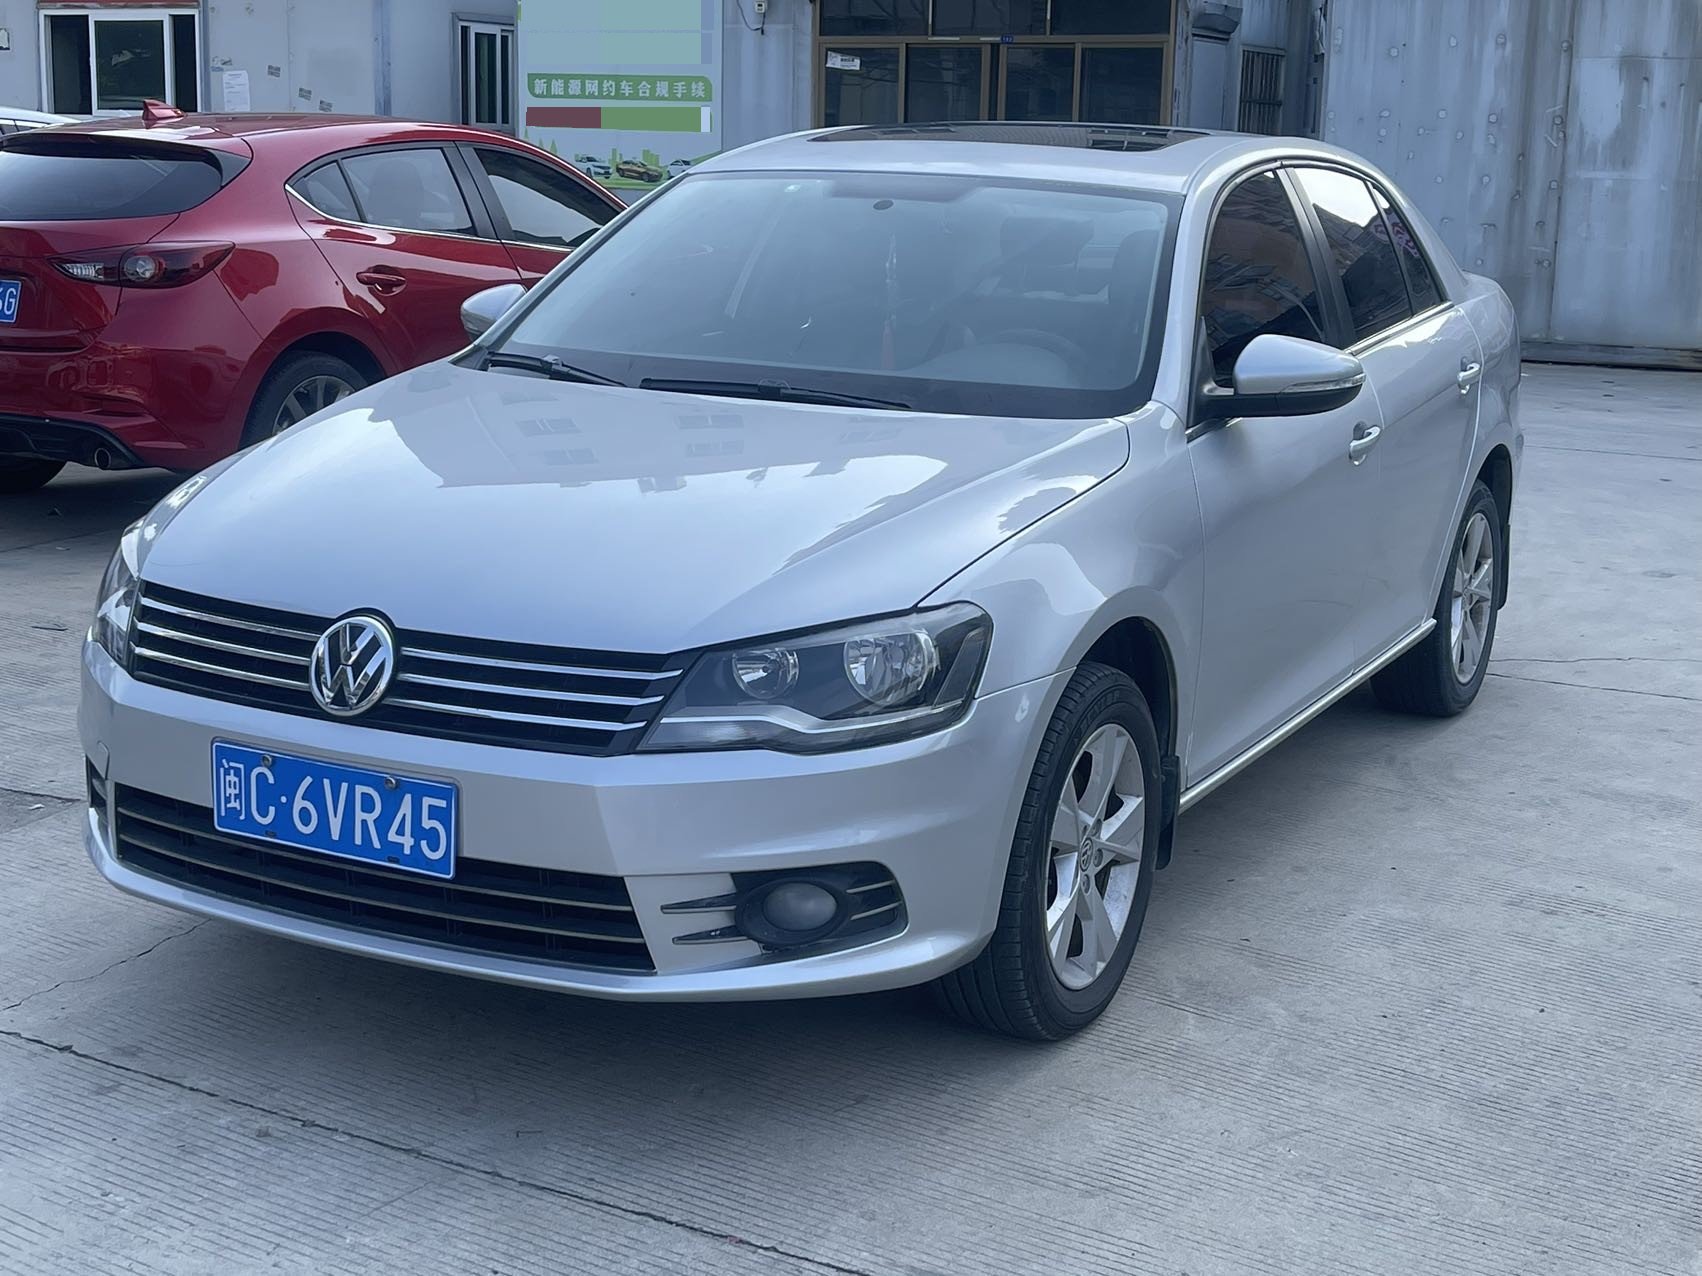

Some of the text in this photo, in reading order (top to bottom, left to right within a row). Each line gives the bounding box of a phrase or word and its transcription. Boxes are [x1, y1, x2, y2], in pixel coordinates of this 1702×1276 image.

[534, 79, 705, 98] 新能源网约车合规手续
[0, 288, 16, 315] G
